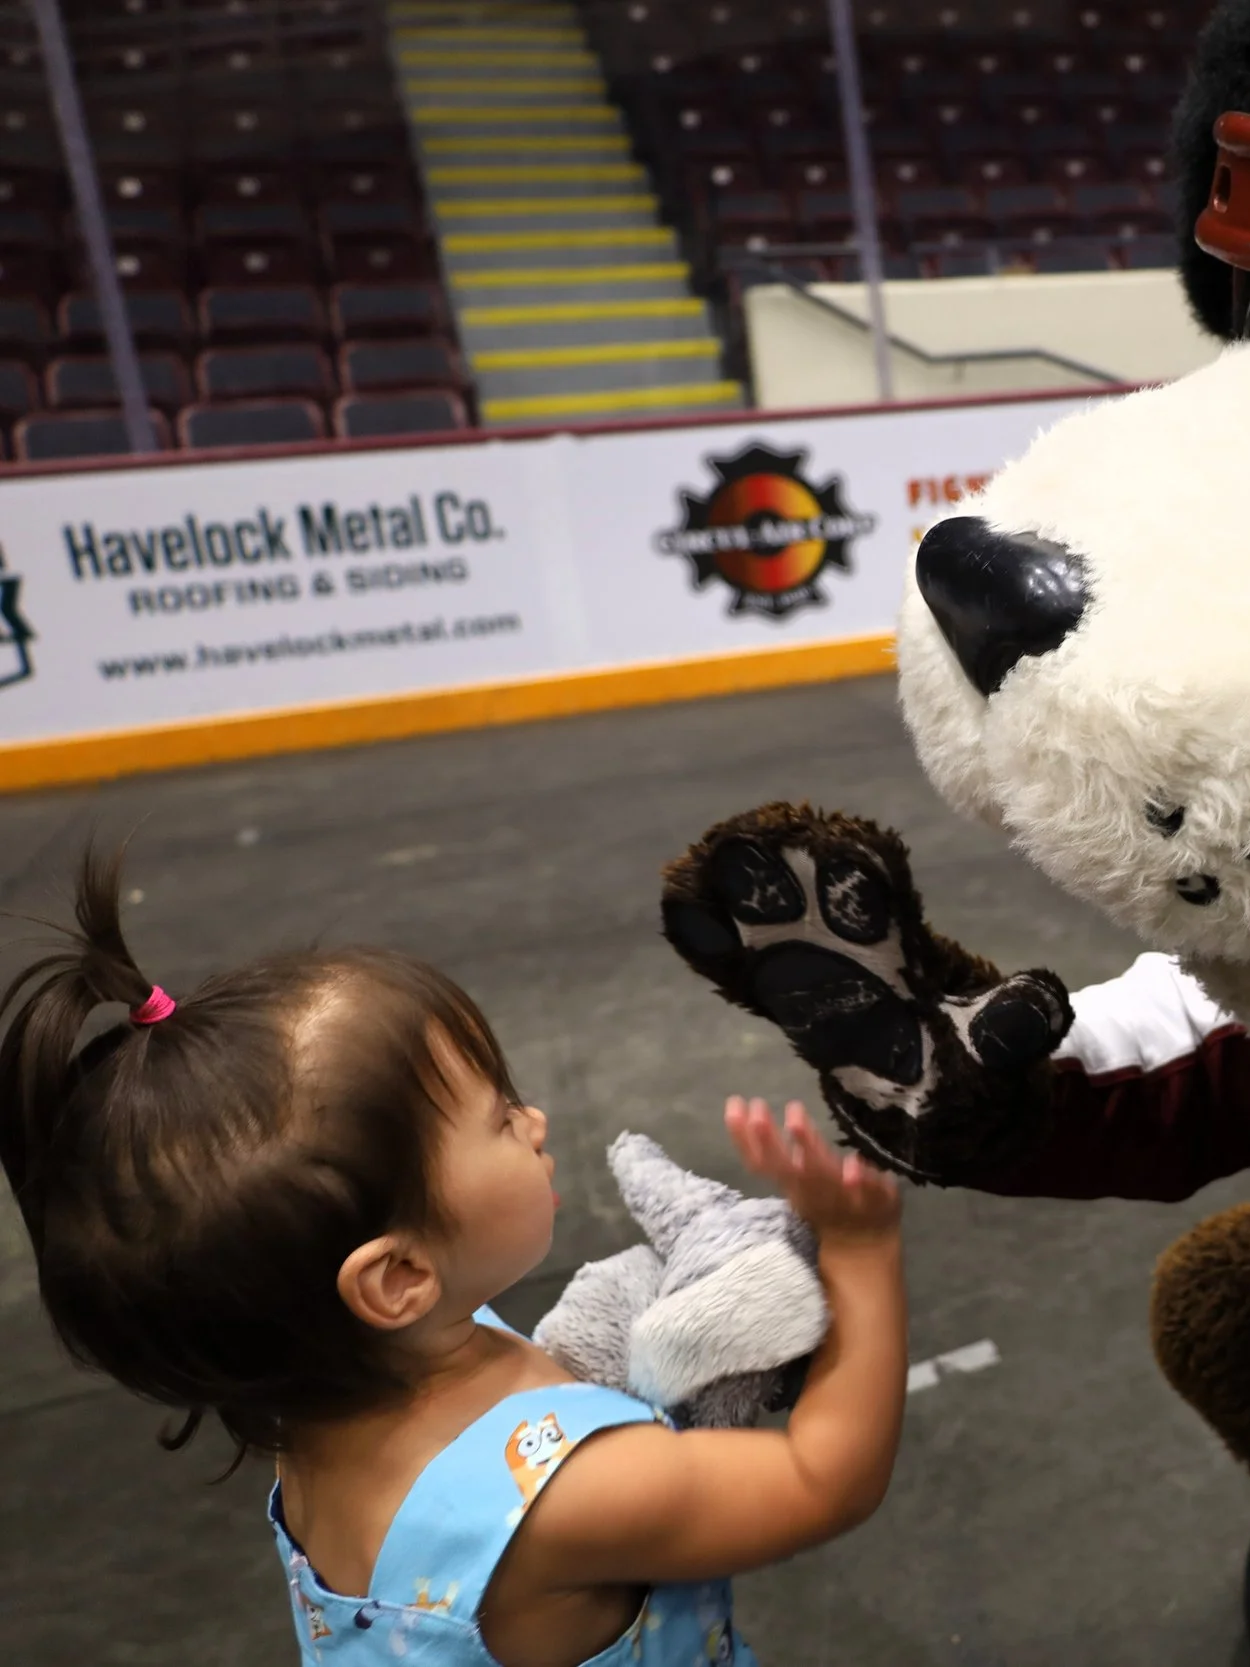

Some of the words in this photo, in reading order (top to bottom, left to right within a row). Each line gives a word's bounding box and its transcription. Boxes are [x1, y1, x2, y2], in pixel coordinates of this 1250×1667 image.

[63, 505, 288, 581] Havelock
[297, 493, 428, 559] Metal
[435, 490, 505, 547] Co.
[128, 573, 301, 616] ROOFING
[311, 574, 335, 597] &
[347, 556, 469, 593] SIDING
[98, 611, 522, 680] www.havelockmetal.com
